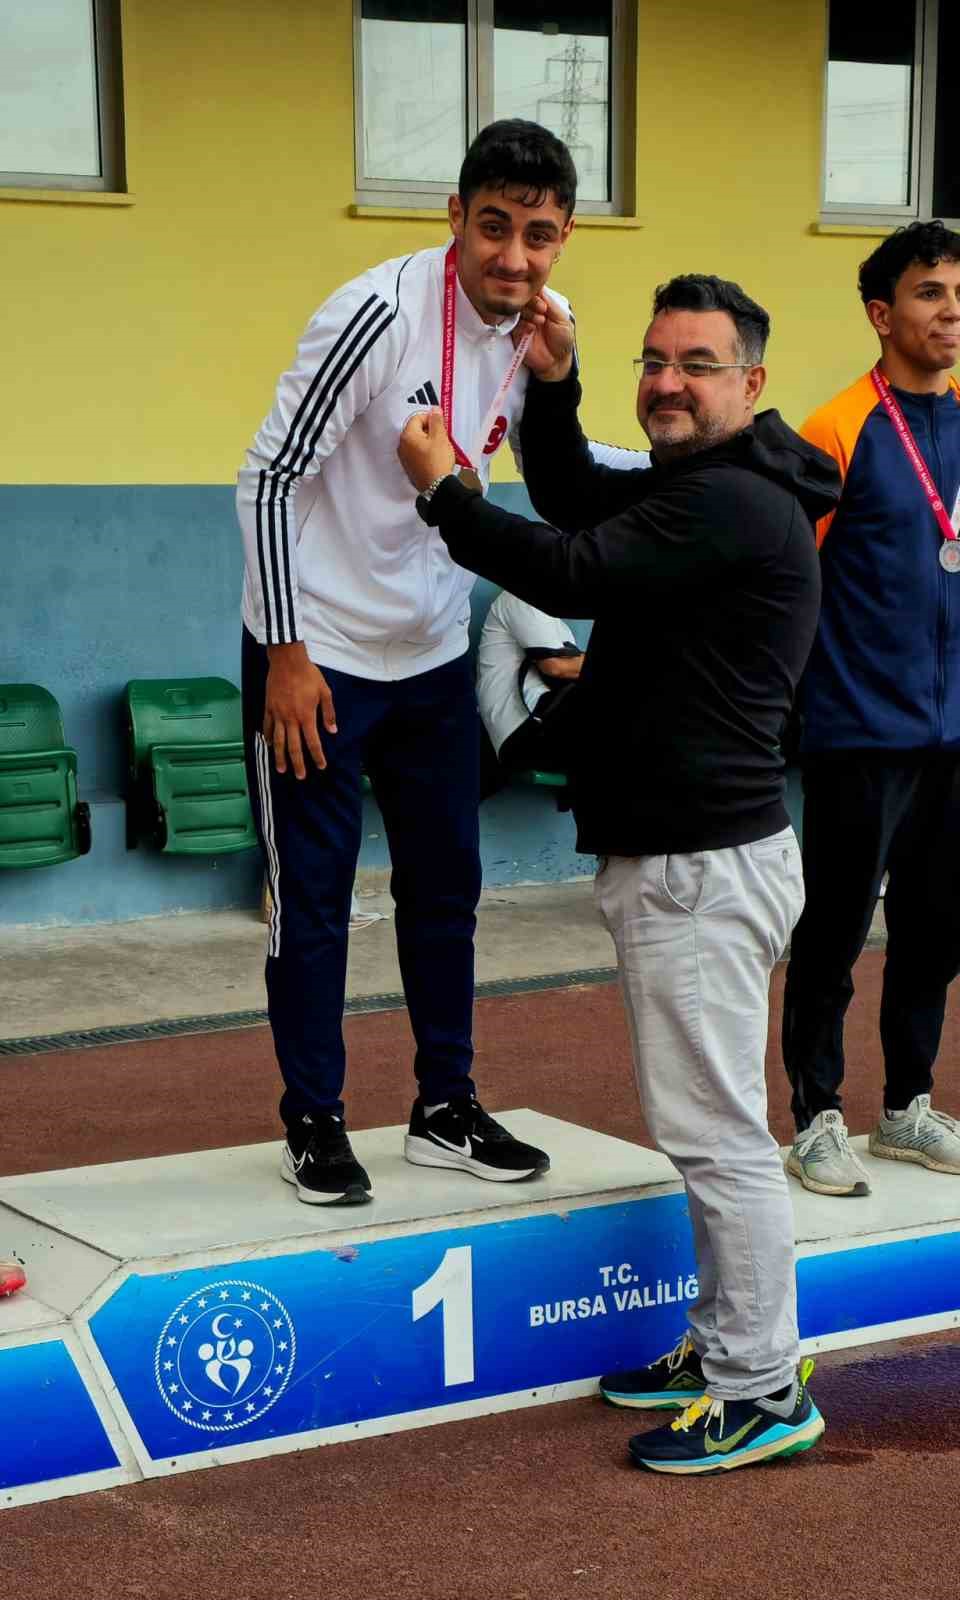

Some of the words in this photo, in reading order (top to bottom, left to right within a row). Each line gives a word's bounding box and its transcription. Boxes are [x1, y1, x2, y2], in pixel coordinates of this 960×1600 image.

[529, 1295, 607, 1328] BURSA
[613, 1273, 700, 1312] VALİLİĞ
[600, 1263, 640, 1288] T.C.
[412, 1245, 474, 1387] 1
